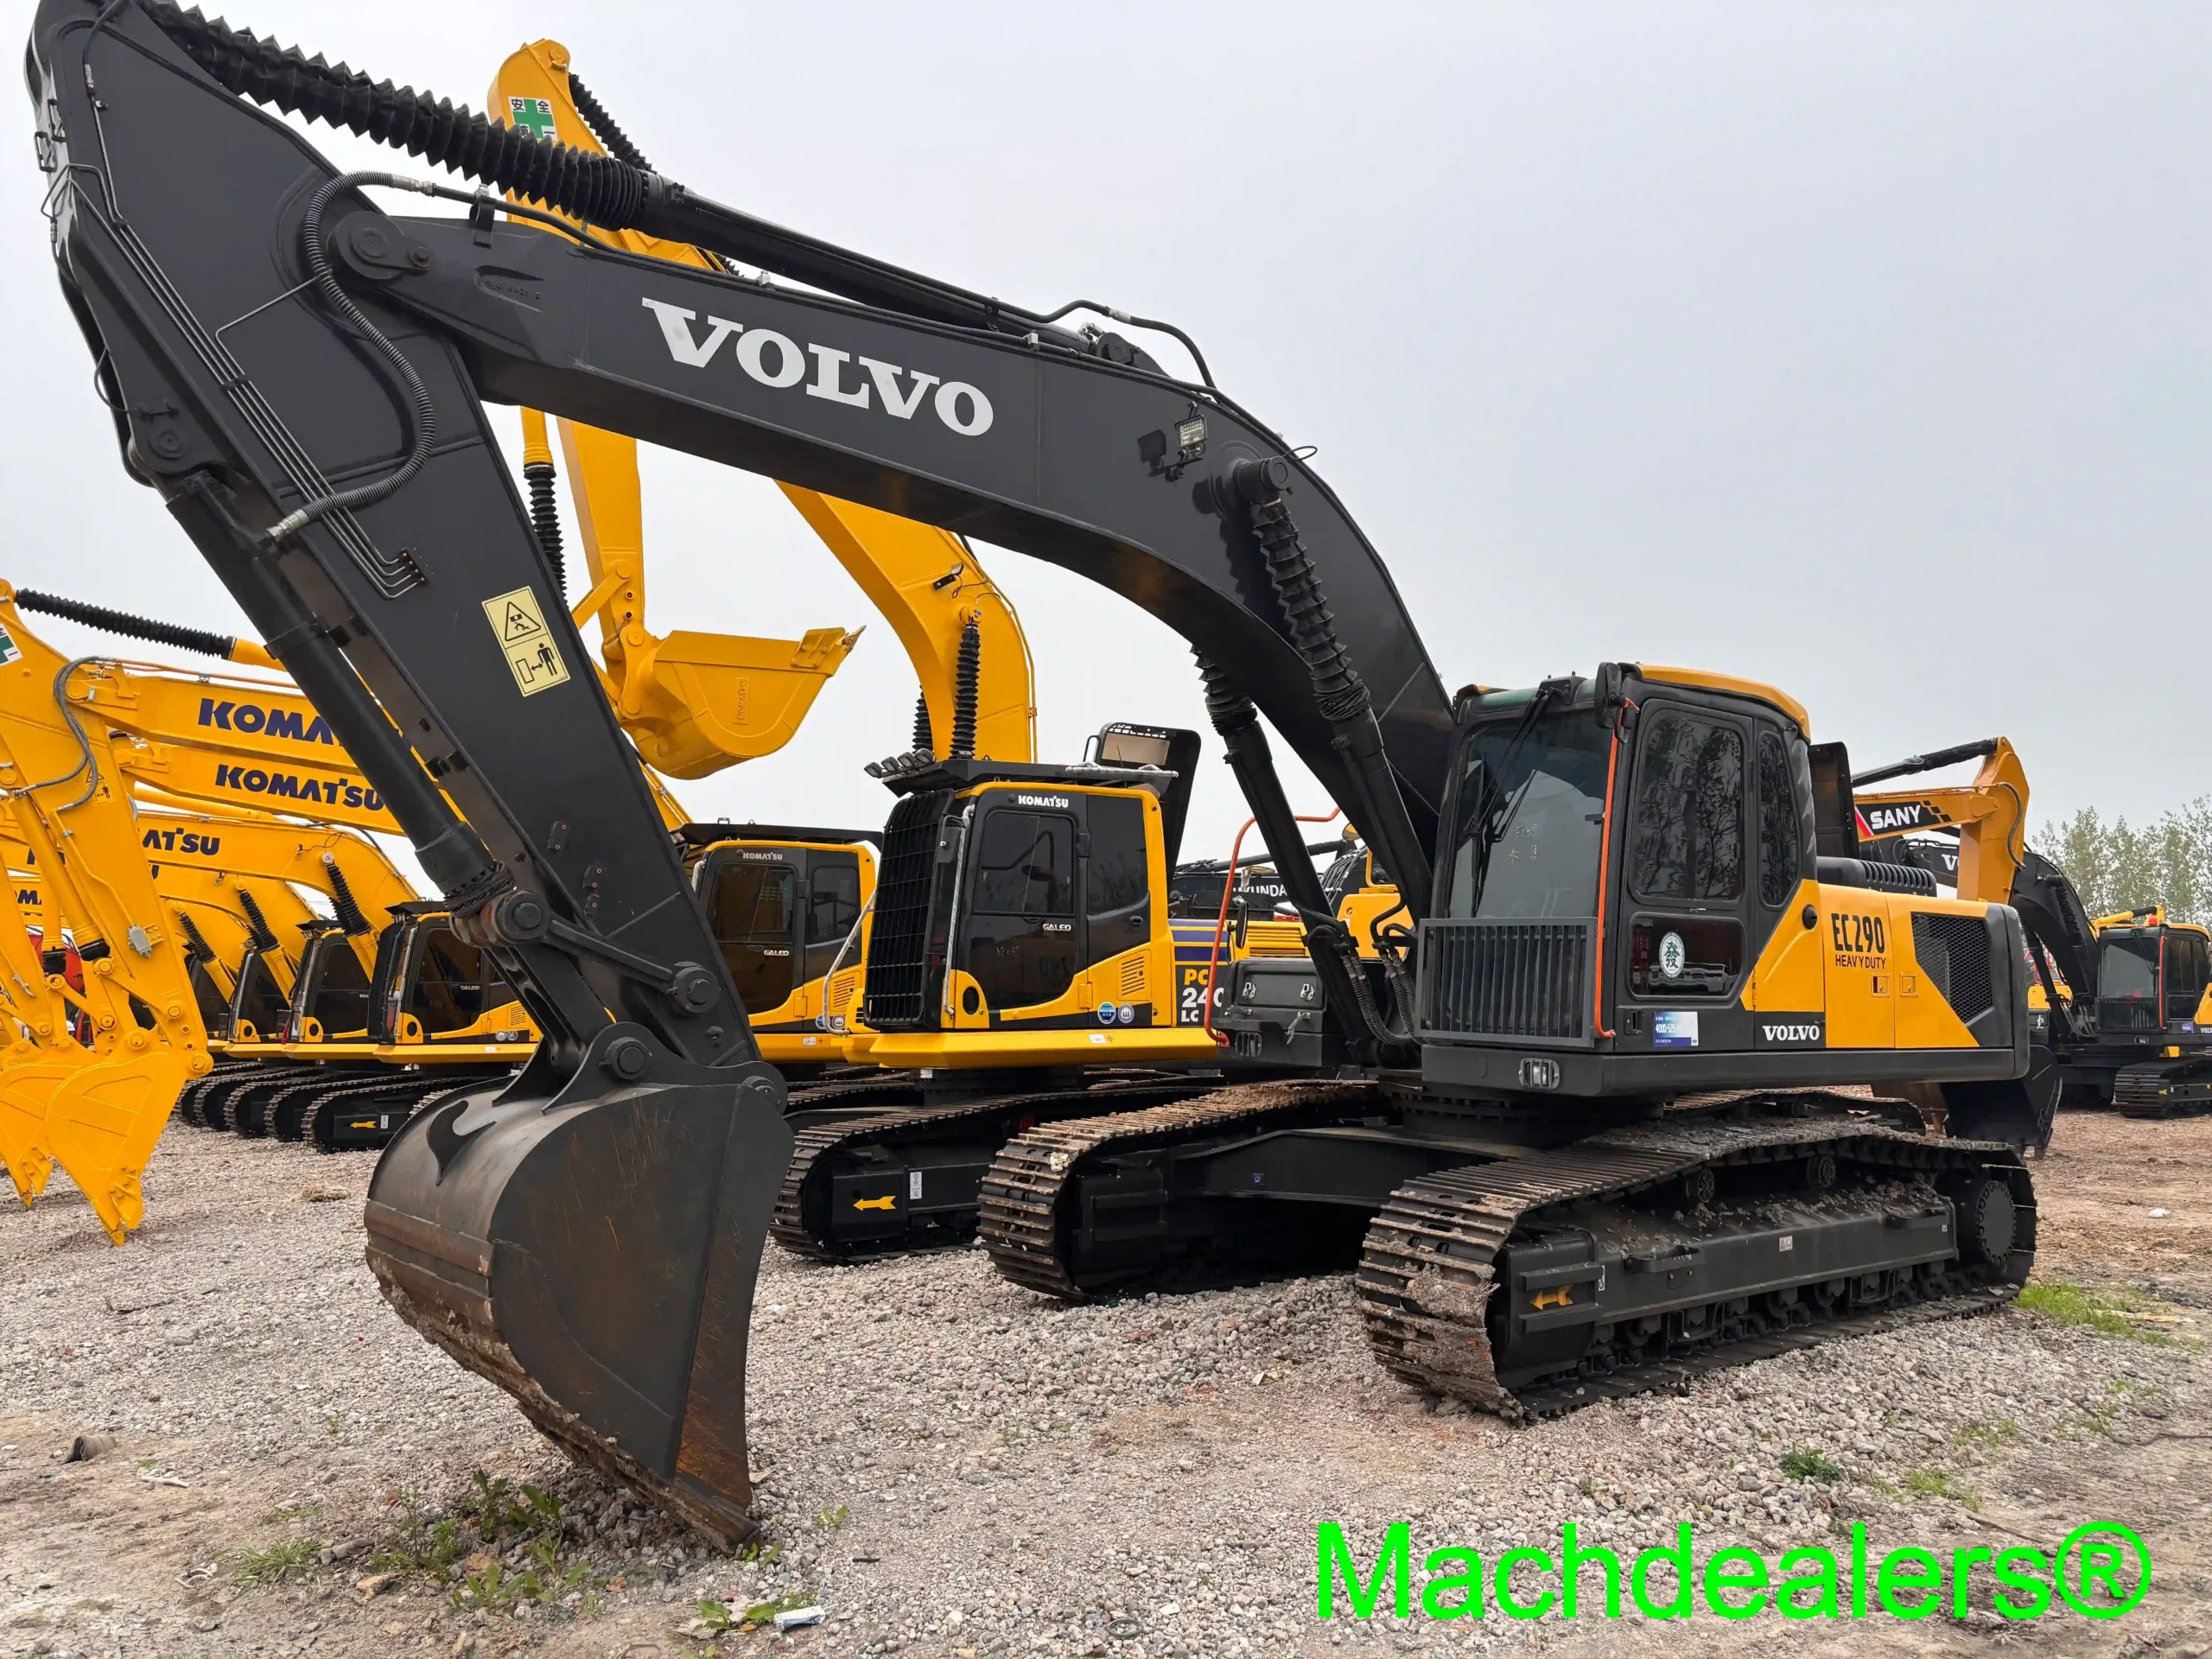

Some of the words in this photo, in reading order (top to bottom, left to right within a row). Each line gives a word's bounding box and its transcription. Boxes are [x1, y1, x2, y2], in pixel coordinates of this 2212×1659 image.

[641, 297, 994, 436] VOLVO
[198, 697, 343, 747] KOMA
[215, 764, 385, 810] KOMATSU
[1018, 794, 1069, 808] KOMATSU
[1870, 804, 1921, 830] SANY
[142, 827, 220, 855] ATSU
[743, 851, 783, 861] KOMATSU
[1042, 923, 1071, 931] GALEO
[1831, 912, 1885, 954] EC290
[1180, 1009, 1199, 1022] LC
[1762, 1025, 1820, 1041] VOLVO
